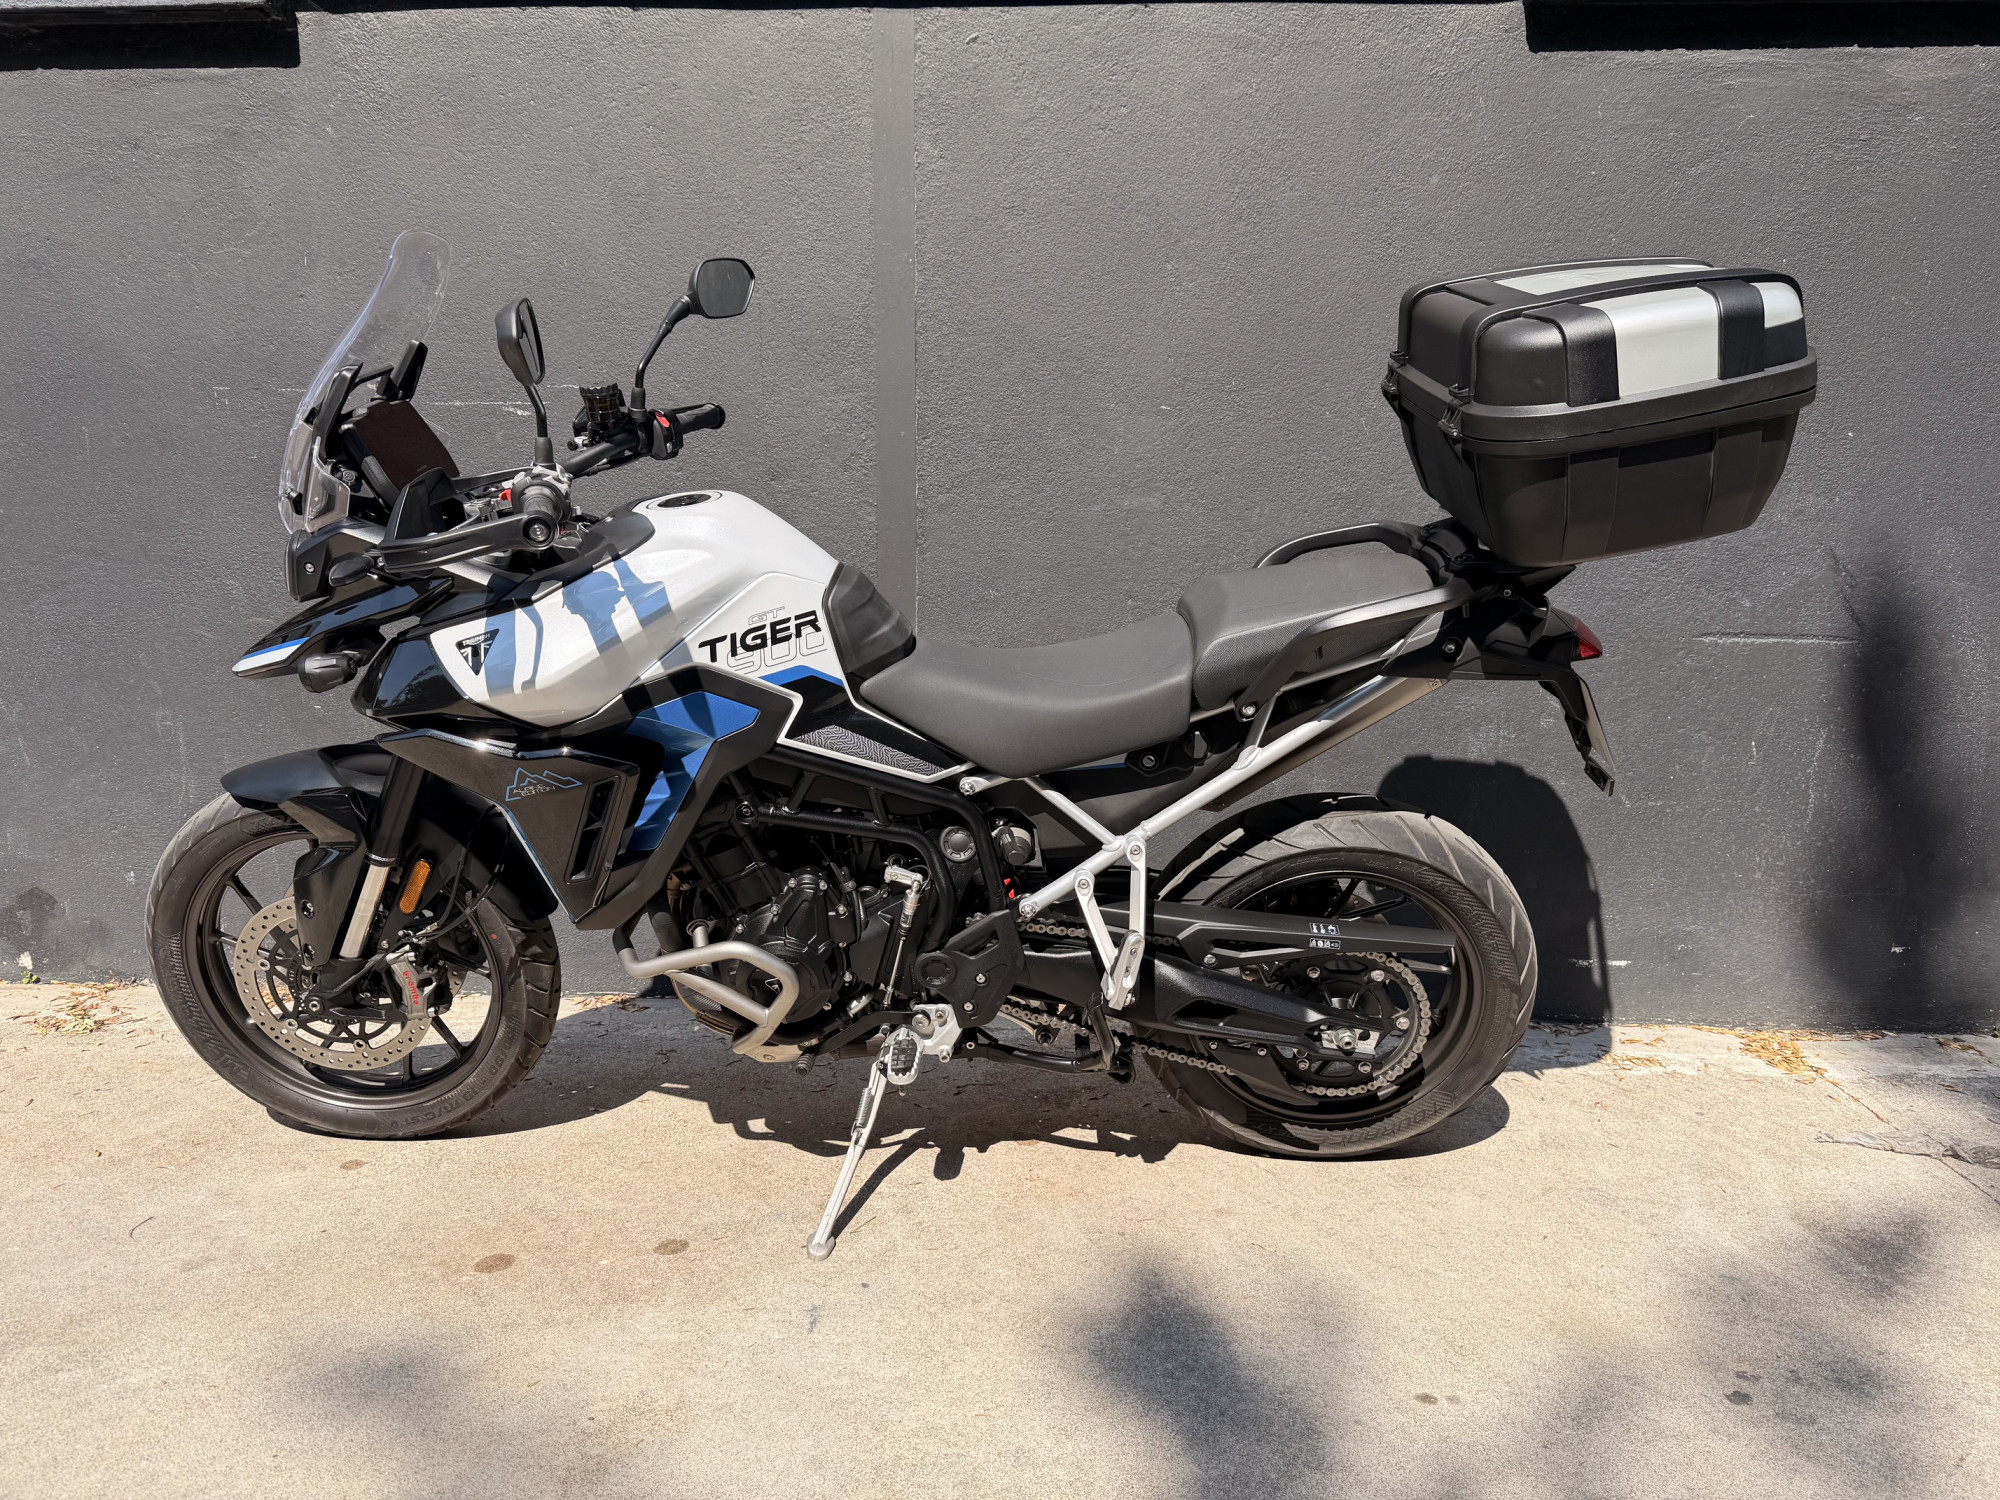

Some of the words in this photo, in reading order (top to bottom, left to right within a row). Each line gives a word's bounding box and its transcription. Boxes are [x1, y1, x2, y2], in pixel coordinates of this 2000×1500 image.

[748, 606, 785, 625] GT
[462, 633, 491, 646] TRIUMPH
[698, 610, 822, 663] TIGER
[403, 970, 421, 1007] brembo
[1320, 1101, 1443, 1146] TOURANCE
